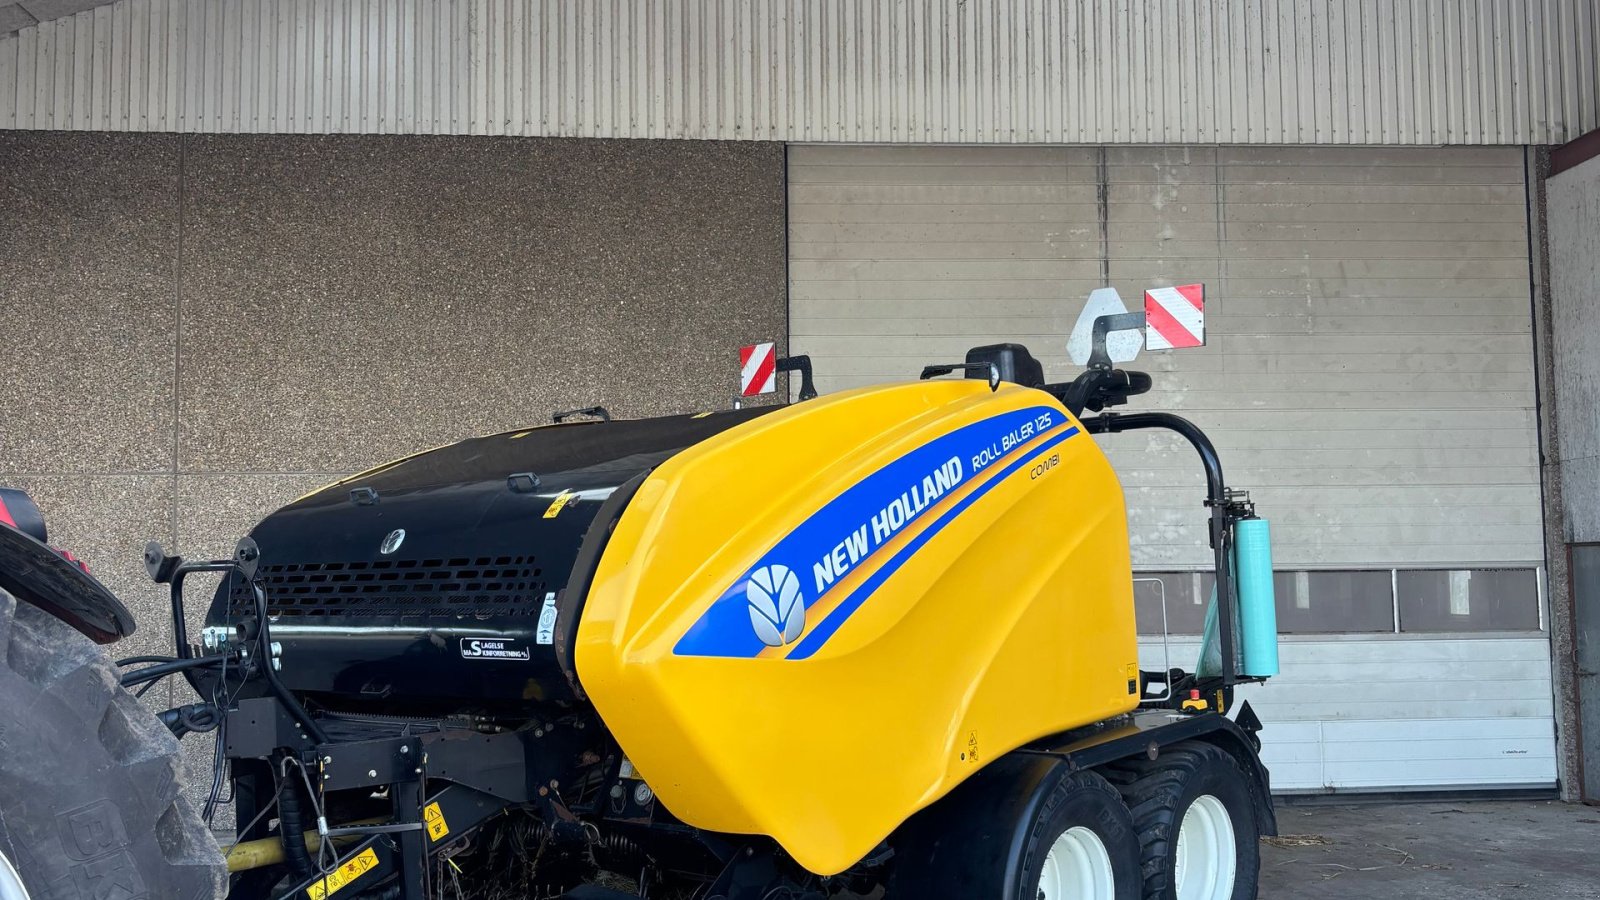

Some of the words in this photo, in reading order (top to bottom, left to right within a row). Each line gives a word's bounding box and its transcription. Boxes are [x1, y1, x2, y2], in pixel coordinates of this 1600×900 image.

[972, 443, 1001, 472] ROLL
[1002, 421, 1034, 452] BALER
[1034, 412, 1052, 432] 125
[1030, 453, 1060, 480] COMBI
[813, 524, 868, 594] NEW
[872, 456, 963, 545] HOLLAND
[60, 799, 143, 900] BK
